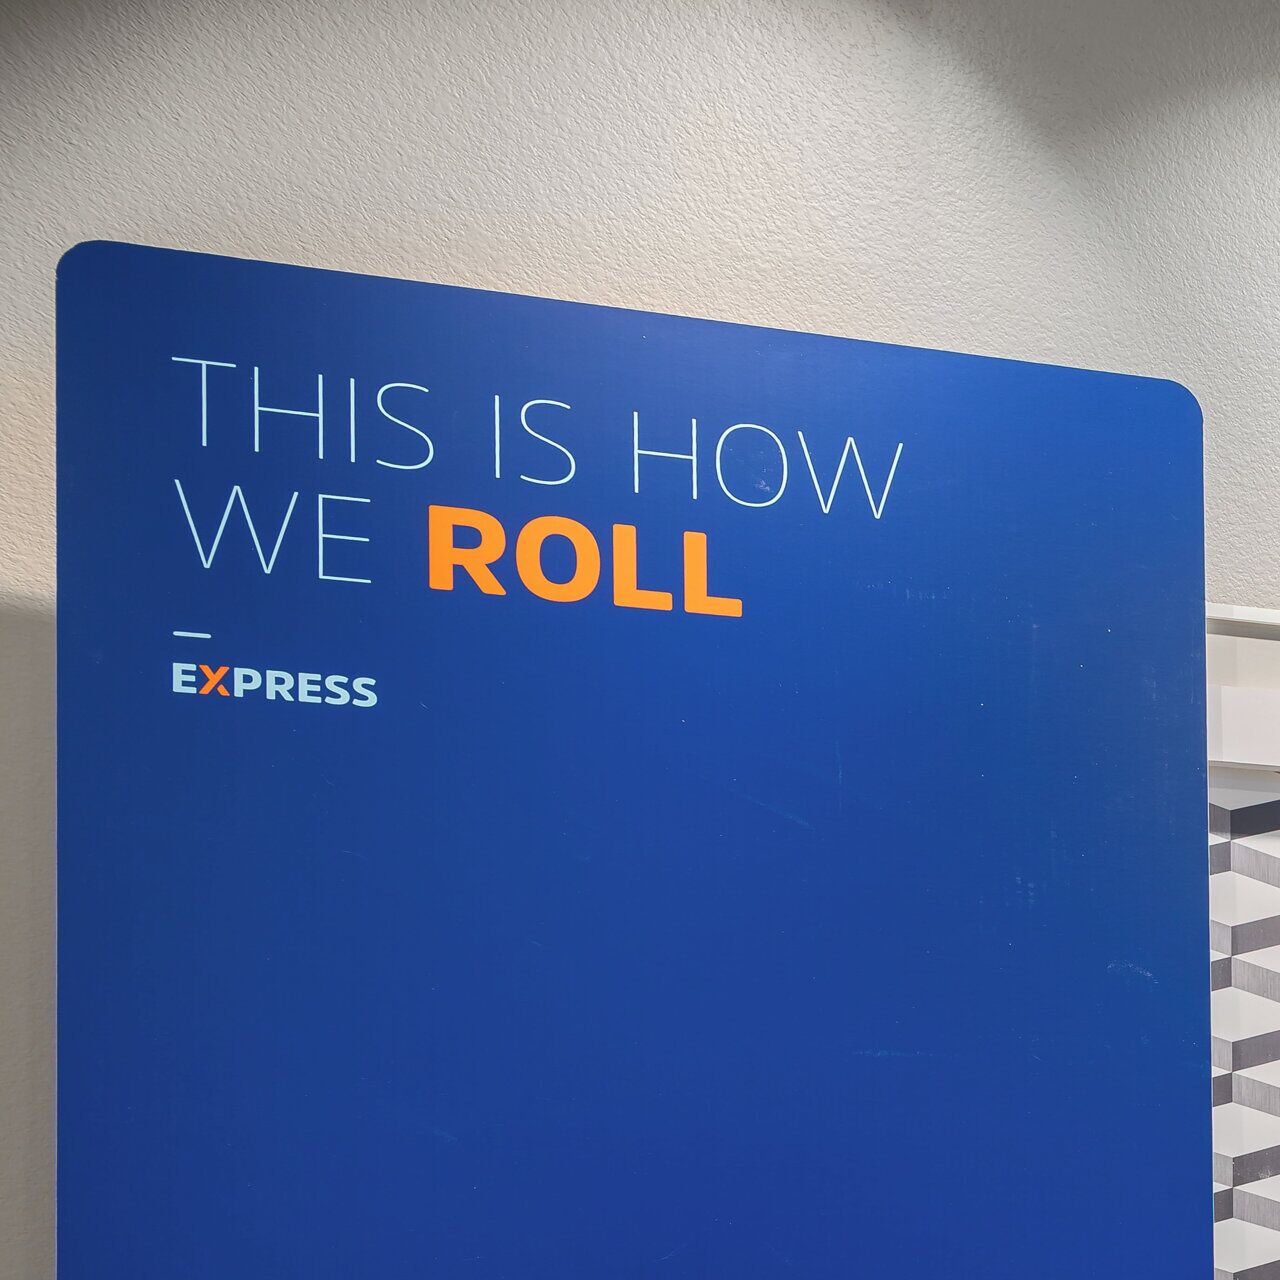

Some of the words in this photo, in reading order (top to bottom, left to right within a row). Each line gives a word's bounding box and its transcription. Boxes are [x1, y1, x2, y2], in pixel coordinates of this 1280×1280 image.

[172, 357, 434, 471] THIS
[494, 394, 576, 485] IS
[633, 411, 903, 519] HOW
[174, 479, 372, 584] WE
[428, 504, 742, 618] ROLL
[172, 662, 378, 709] EXPRESS
